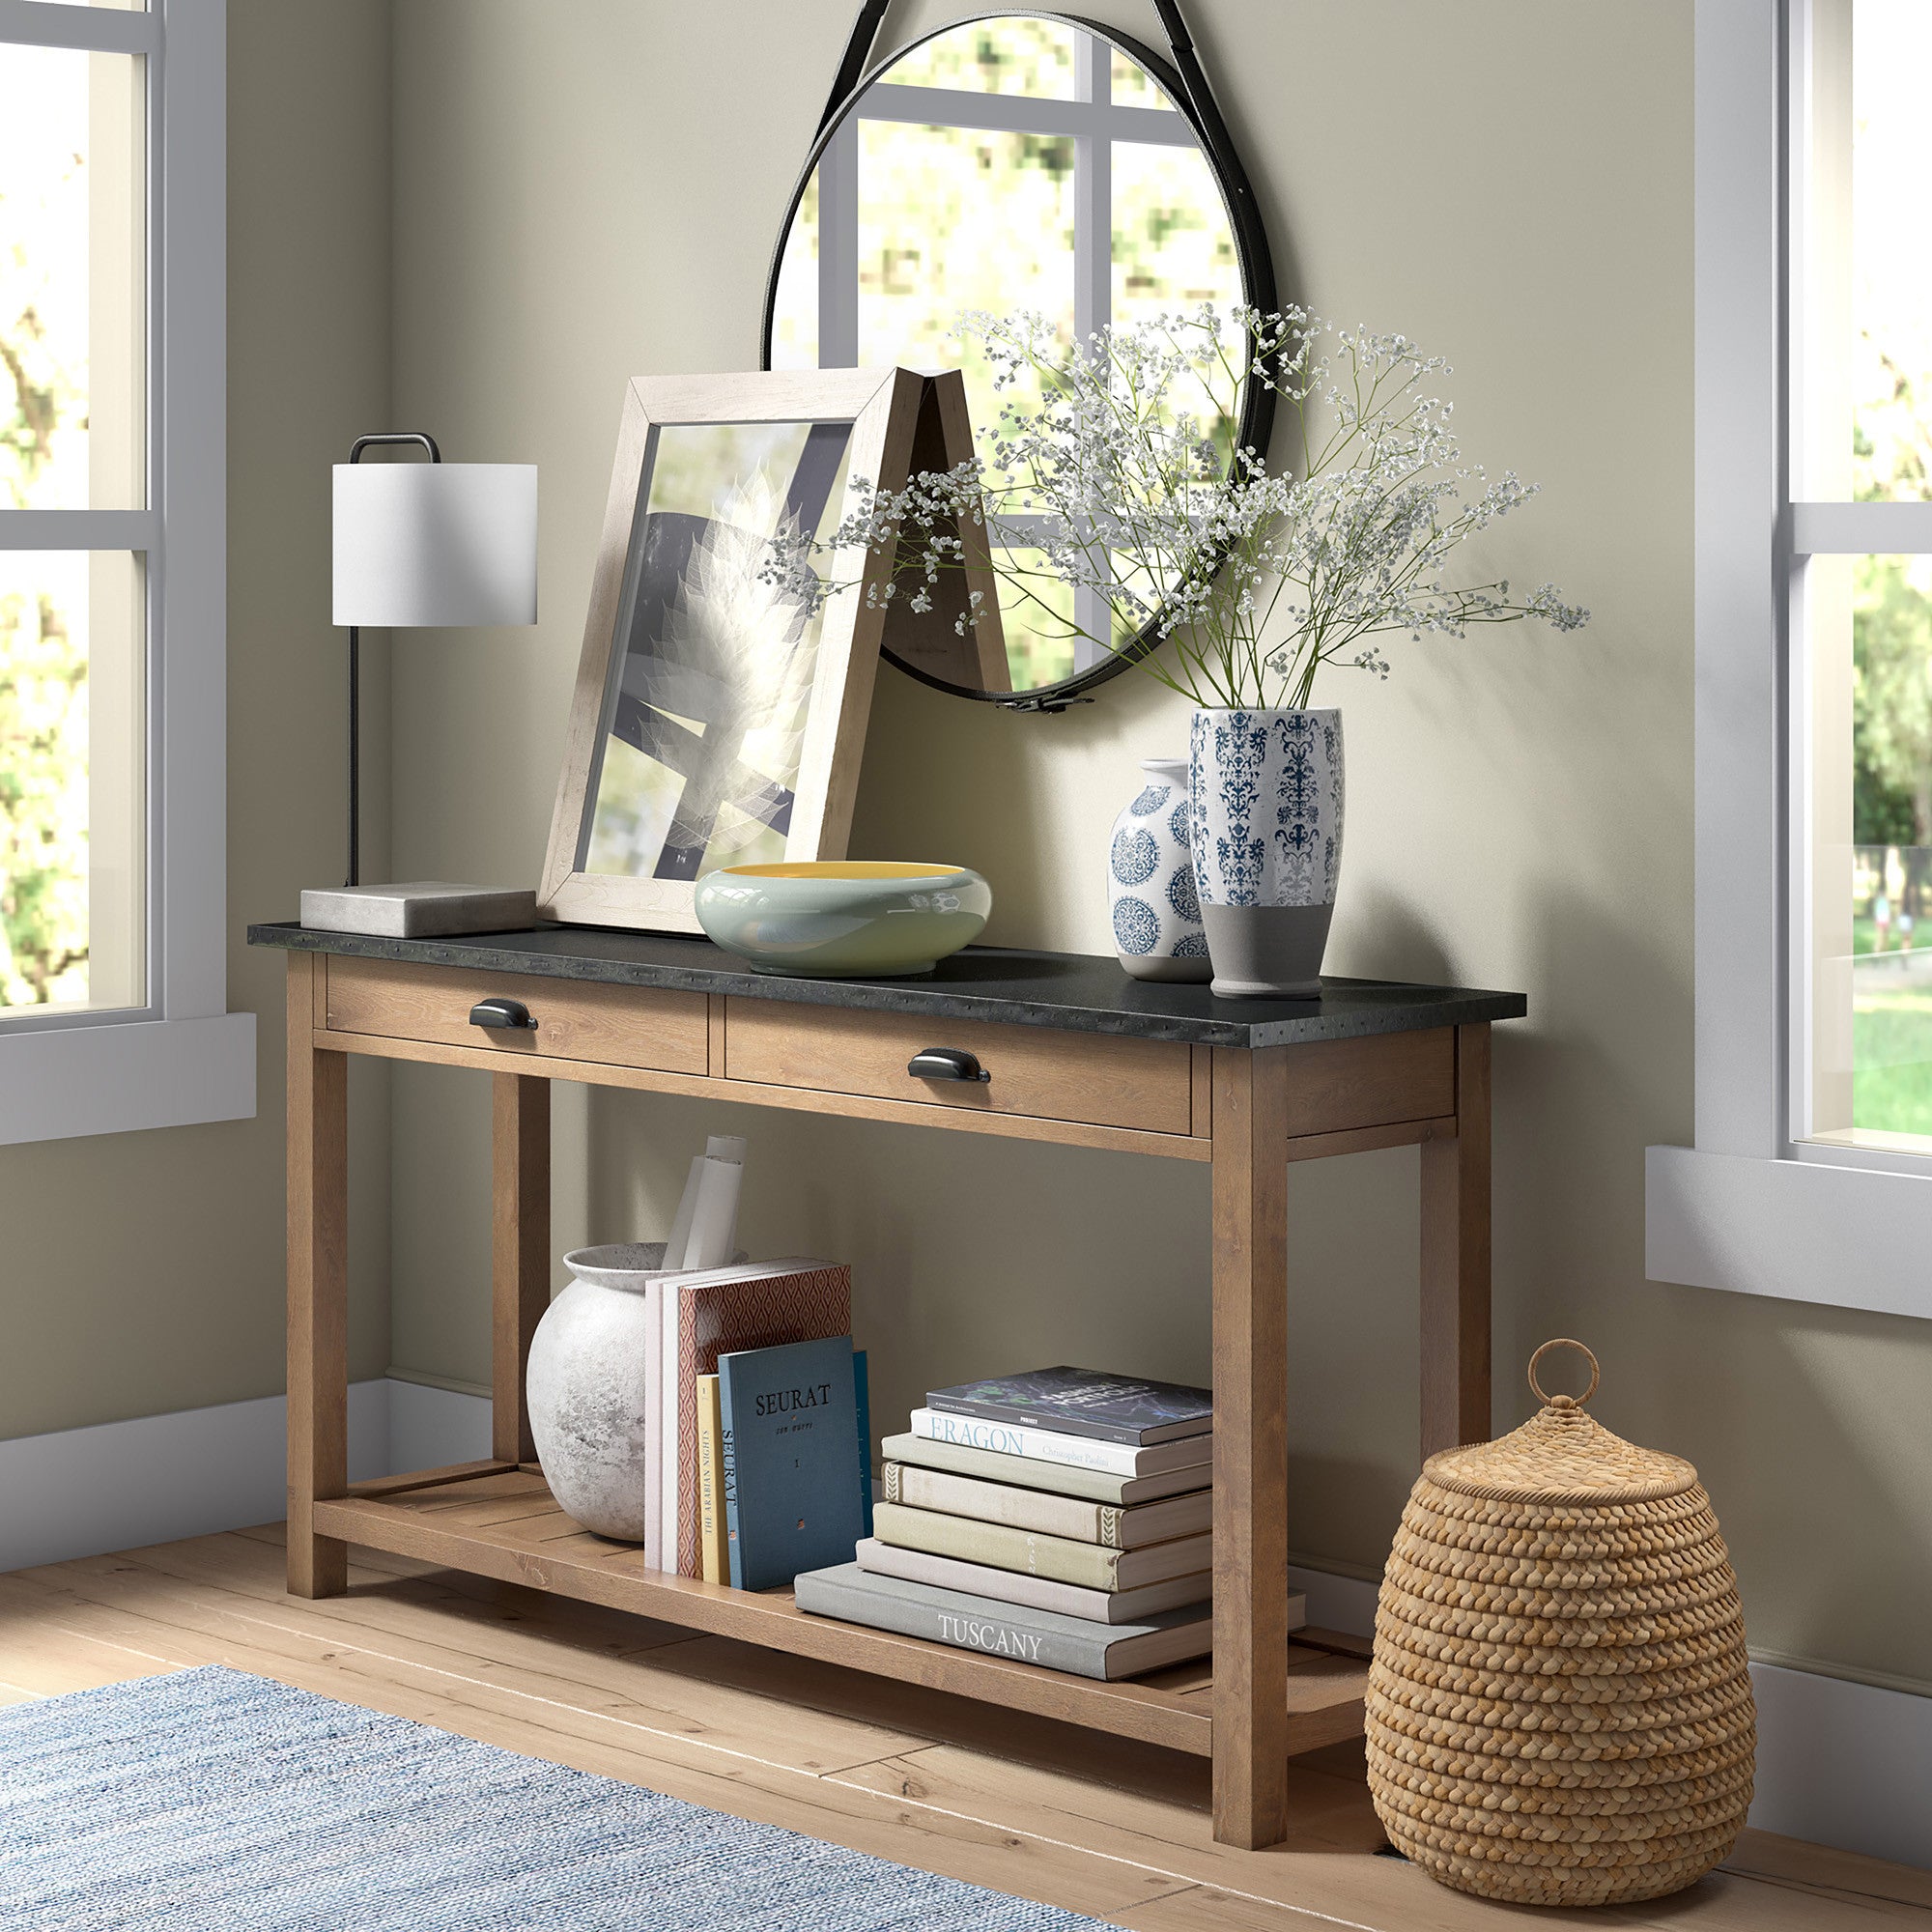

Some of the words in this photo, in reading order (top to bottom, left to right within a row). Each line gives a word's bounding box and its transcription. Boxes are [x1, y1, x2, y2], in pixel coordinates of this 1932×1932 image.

[755, 1383, 832, 1416] SEURAT
[702, 1430, 711, 1466] NIGHTS
[930, 1416, 1025, 1456] ERAGON
[723, 1430, 738, 1507] SEURAT
[703, 1470, 712, 1513] ARABIAN
[704, 1516, 713, 1534] THE
[938, 1614, 1043, 1661] TUSCANY
